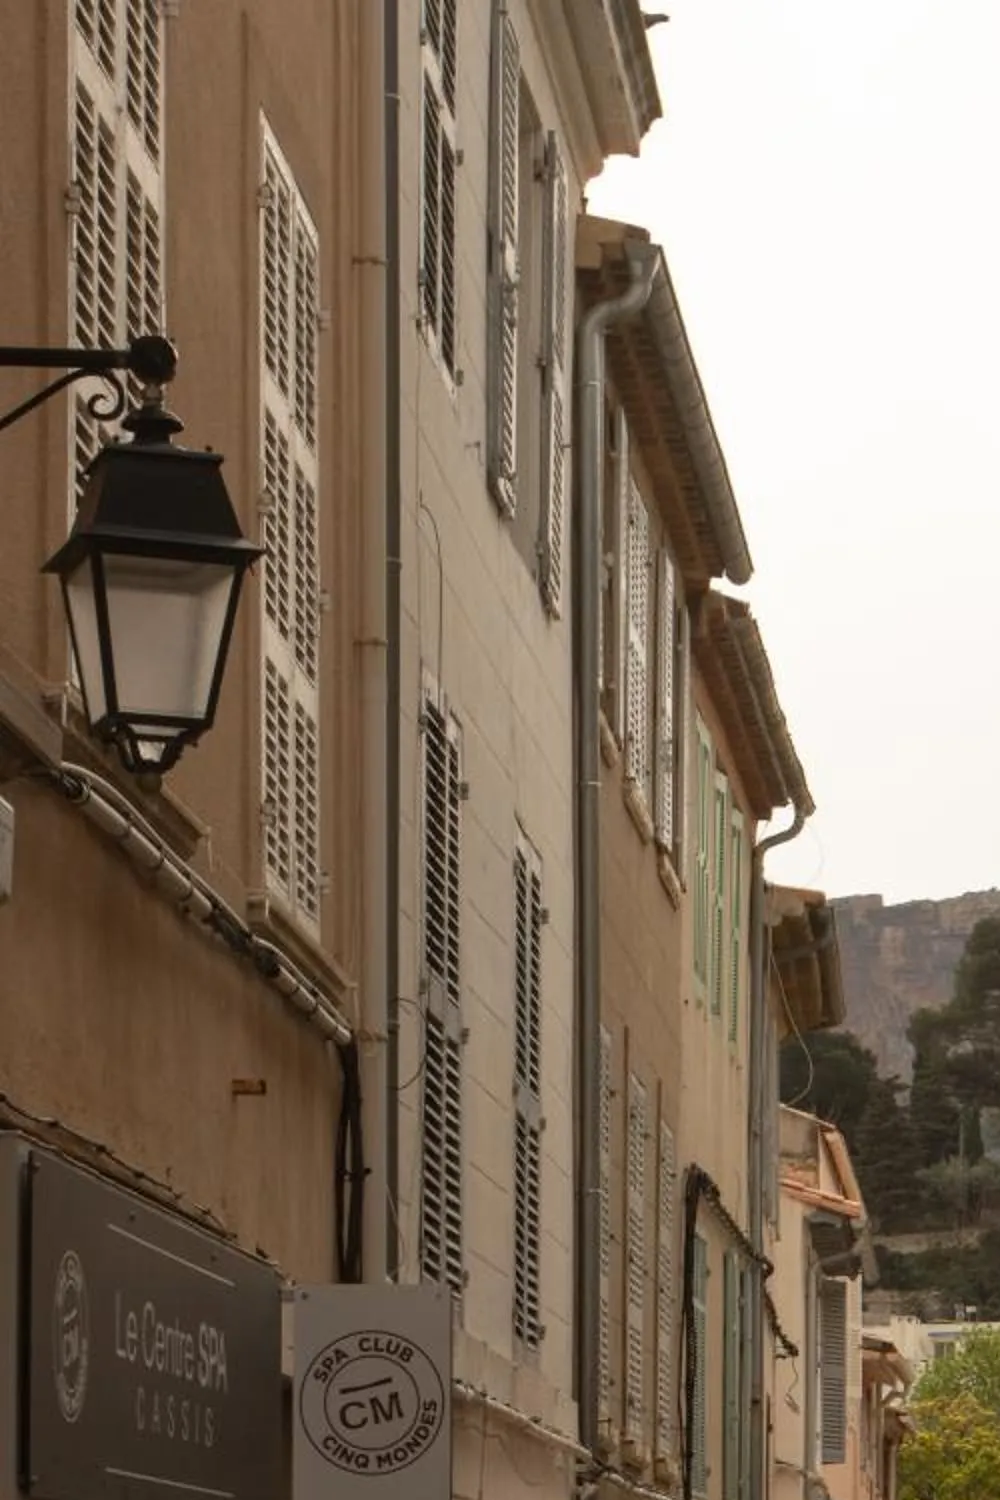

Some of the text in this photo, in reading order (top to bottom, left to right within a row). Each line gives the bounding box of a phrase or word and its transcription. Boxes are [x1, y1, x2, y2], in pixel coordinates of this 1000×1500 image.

[114, 1290, 229, 1395] Le Centre SPA
[313, 1336, 415, 1385] SPA CLUB
[136, 1384, 216, 1449] CASSIS
[321, 1398, 438, 1470] CINQ MONDES
[338, 1390, 405, 1430] CM
